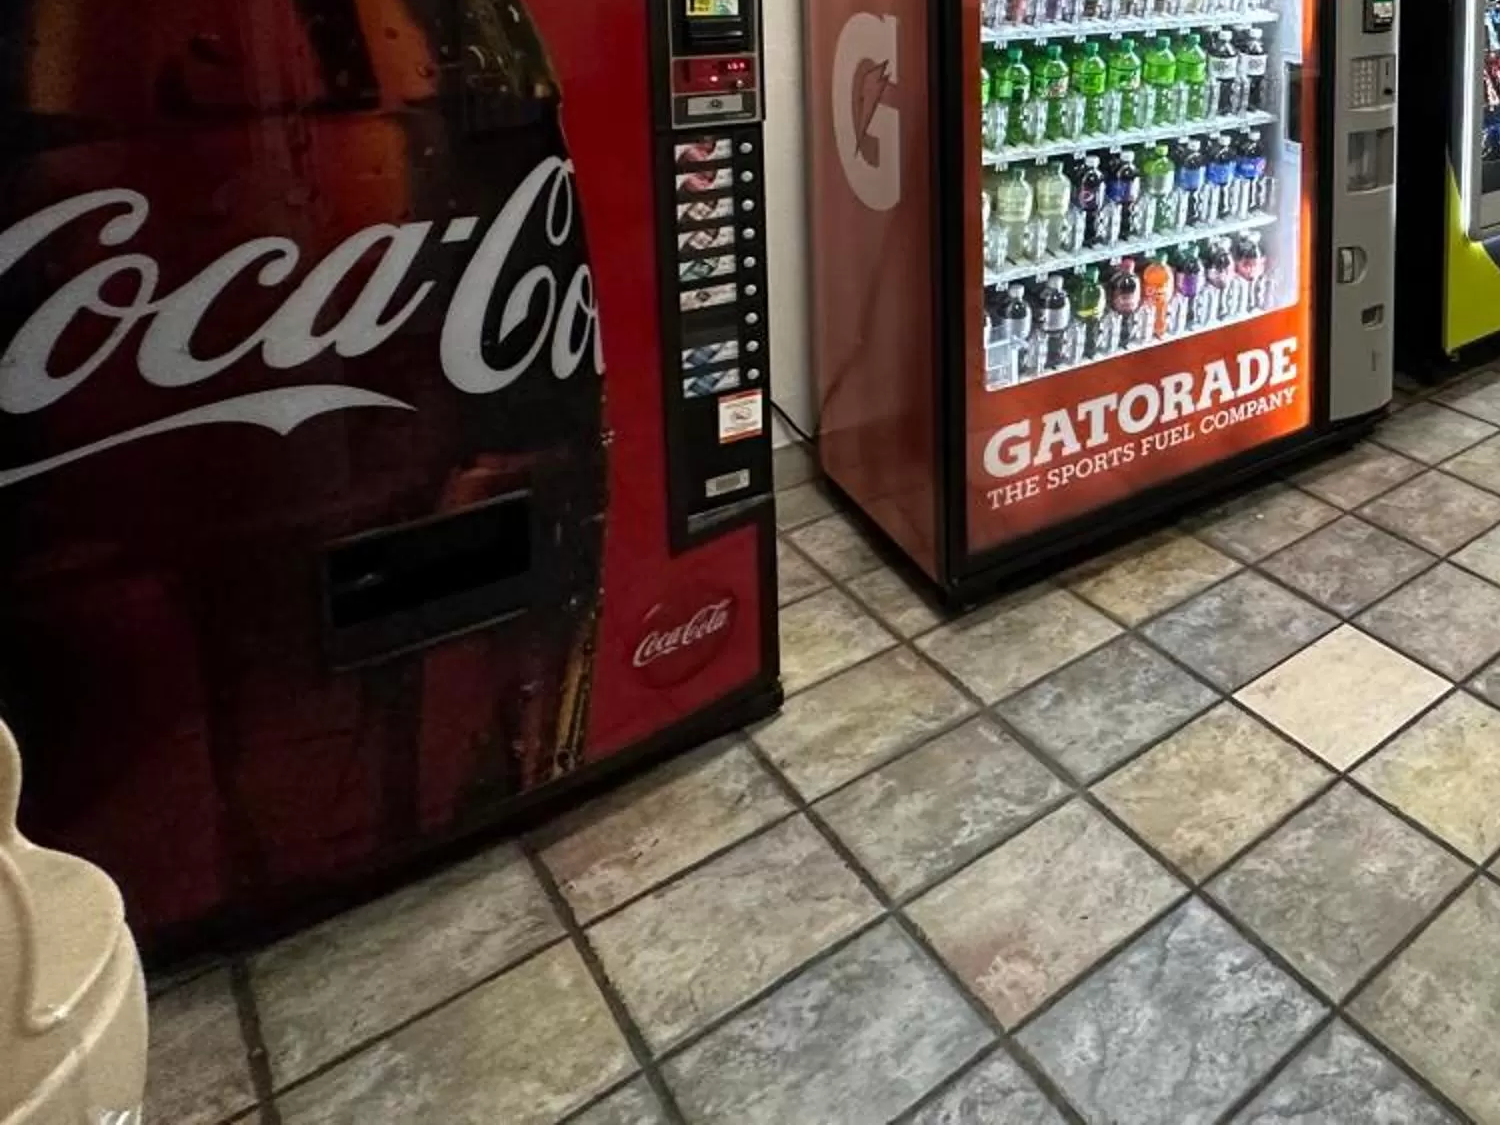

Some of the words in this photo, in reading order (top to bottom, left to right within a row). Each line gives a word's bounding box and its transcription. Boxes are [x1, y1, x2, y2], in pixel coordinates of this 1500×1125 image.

[0, 148, 607, 416] oca-Co
[983, 336, 1299, 479] GATORADE
[987, 475, 1041, 510] THE
[1046, 443, 1135, 491] SPORTS
[1141, 421, 1195, 458] FUEL
[1199, 385, 1297, 435] COMPANY
[632, 597, 732, 668] Coca-Cola
